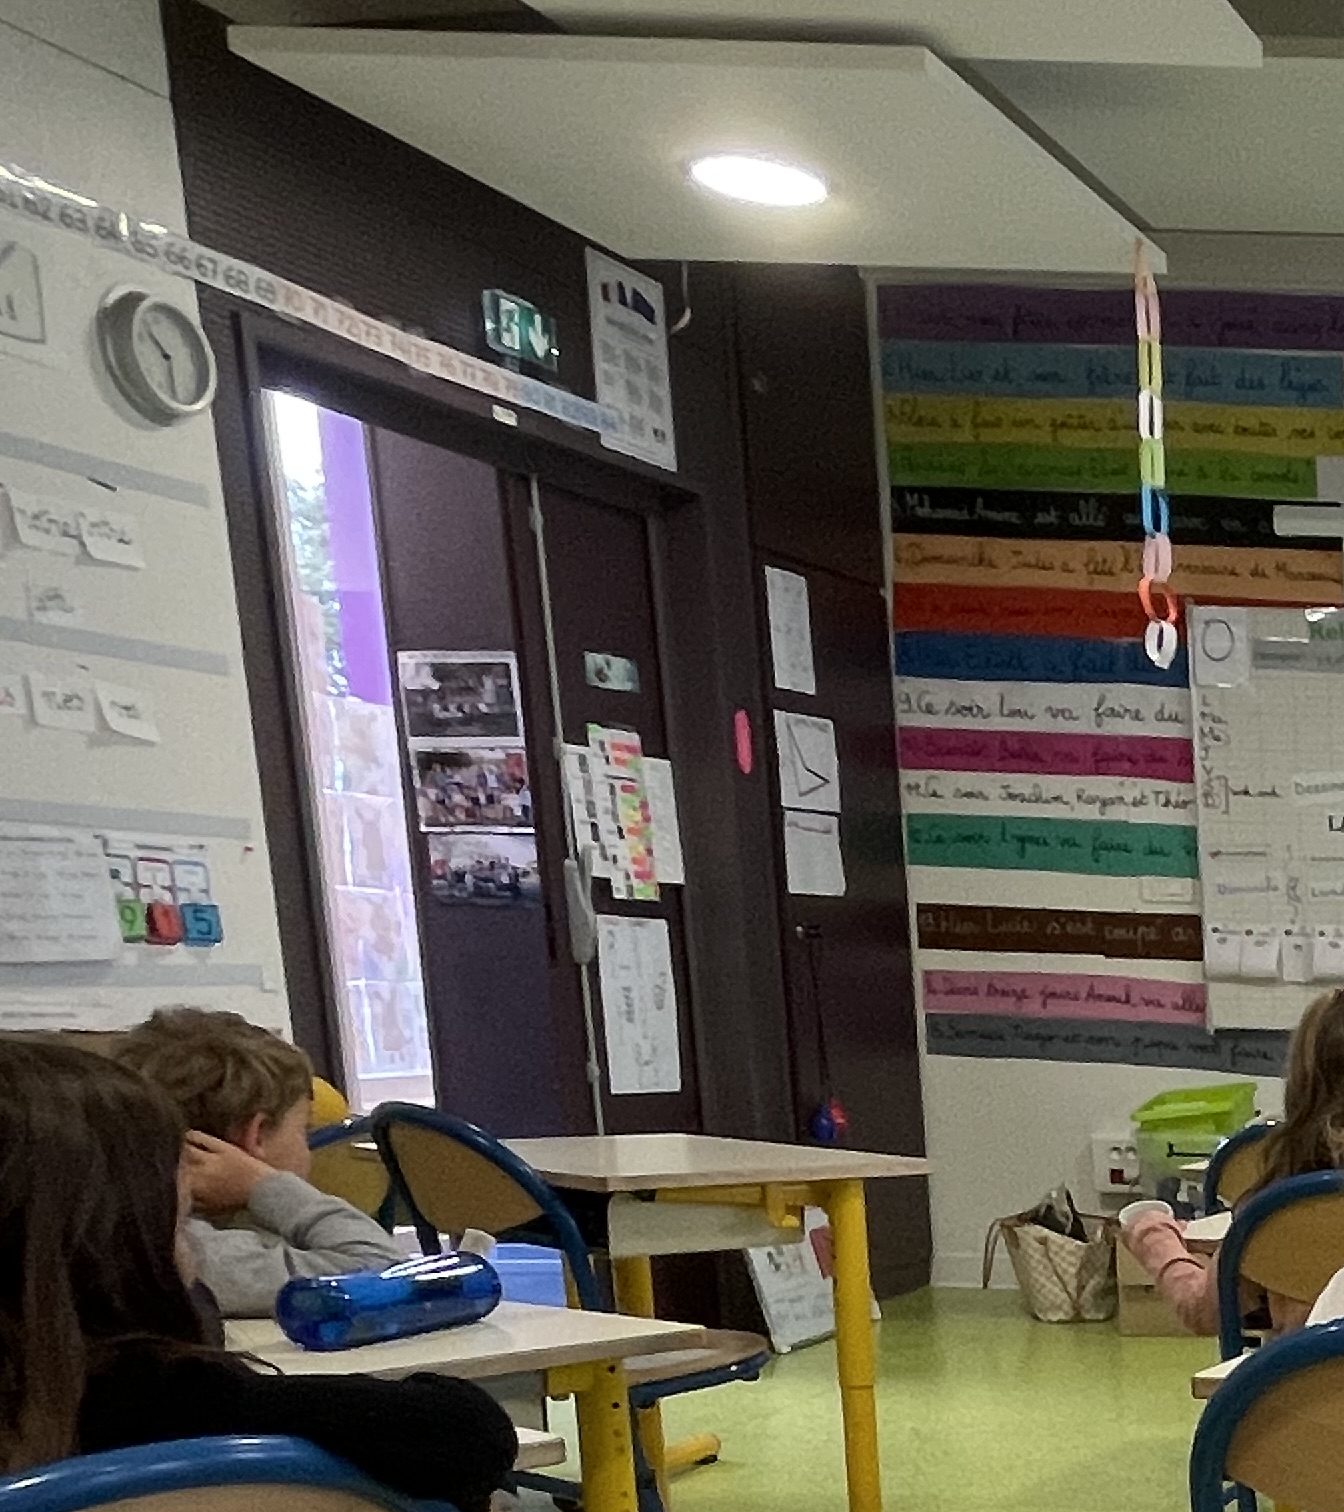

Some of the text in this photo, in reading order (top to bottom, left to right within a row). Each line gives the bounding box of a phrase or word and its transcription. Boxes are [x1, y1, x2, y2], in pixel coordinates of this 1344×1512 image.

[59, 203, 89, 232] 63
[95, 214, 122, 242] 64
[163, 242, 193, 270] 66
[195, 254, 218, 280] 67
[223, 265, 251, 294] 68
[944, 701, 992, 720] soir
[1000, 693, 1036, 721] Lou
[1045, 704, 1080, 722] va
[1094, 693, 1146, 728] faire
[1154, 702, 1184, 724] du
[1132, 788, 1149, 808] et
[1091, 834, 1134, 864] faire
[191, 906, 215, 937] 5
